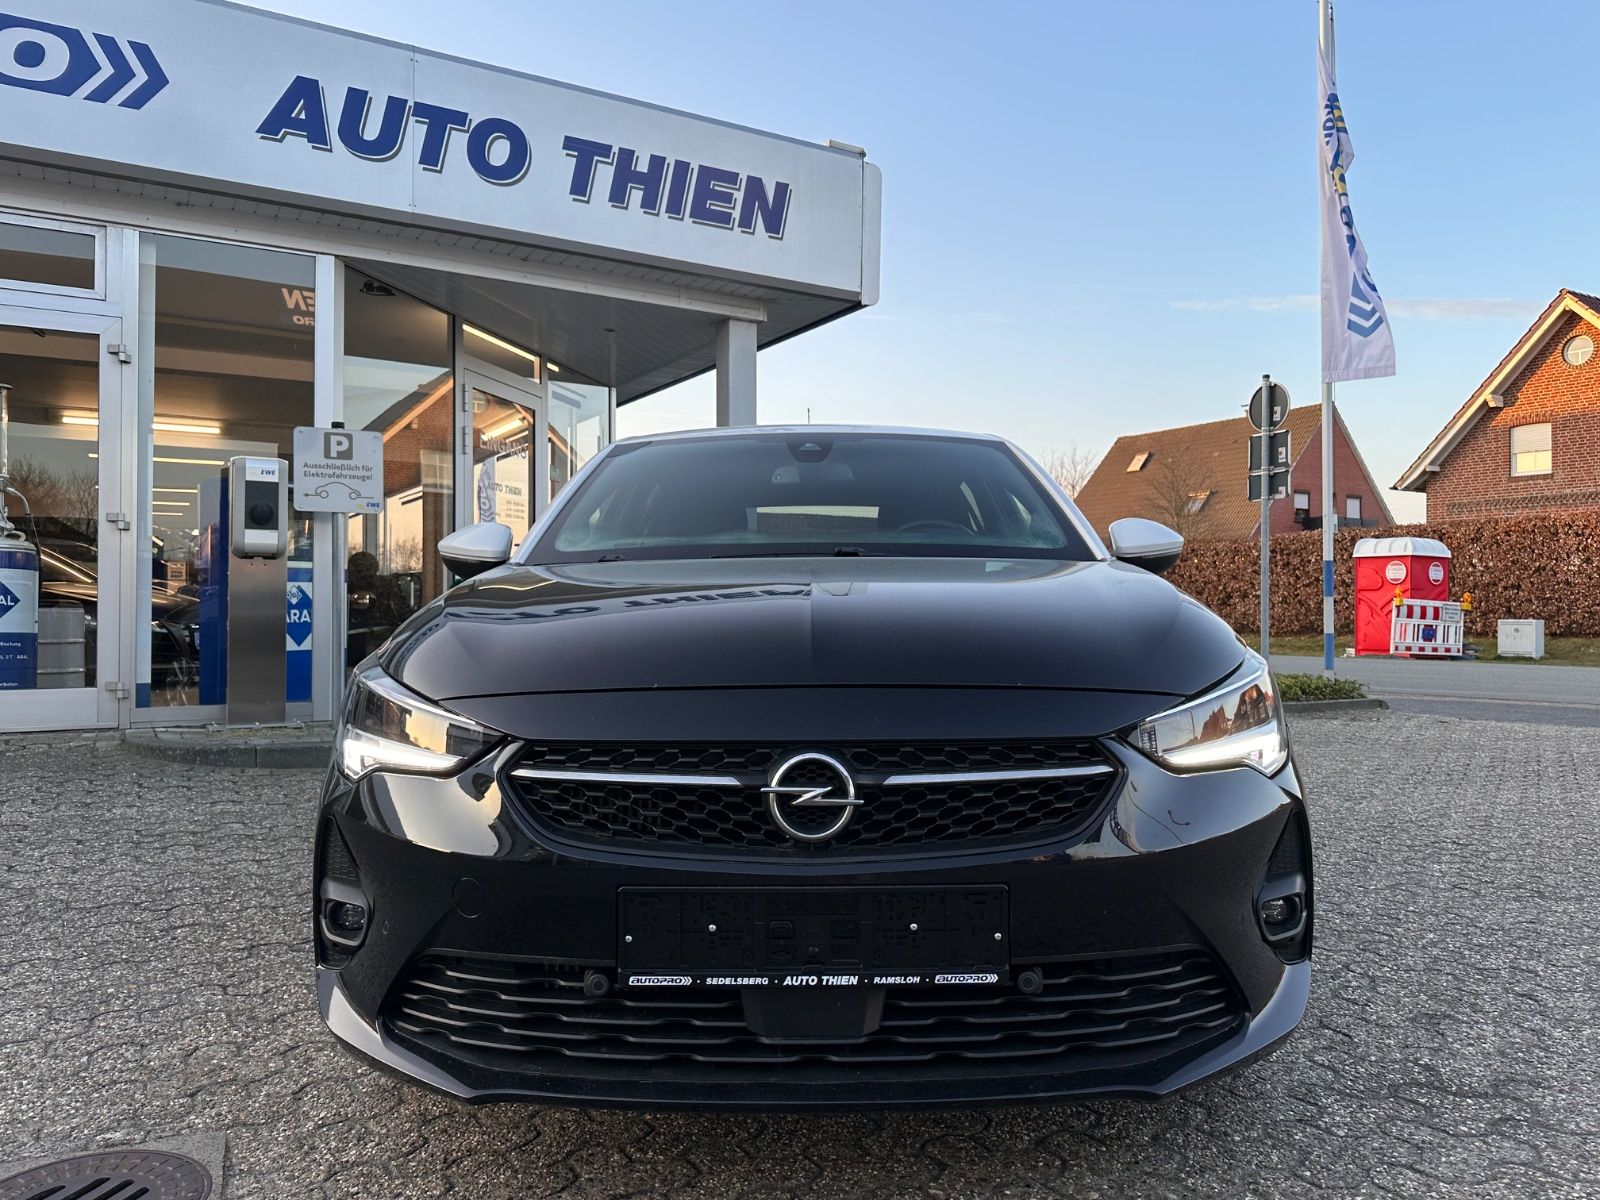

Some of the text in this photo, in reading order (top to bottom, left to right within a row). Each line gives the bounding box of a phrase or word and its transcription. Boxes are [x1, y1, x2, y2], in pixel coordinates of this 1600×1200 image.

[255, 74, 792, 240] AUTO THIEN
[330, 434, 350, 458] P
[303, 462, 360, 471] Ausschließlich
[706, 977, 769, 985] SEDELSBERG
[783, 975, 818, 986] AUTO
[821, 975, 858, 985] THIEN
[873, 976, 920, 984] RAMSLOH
